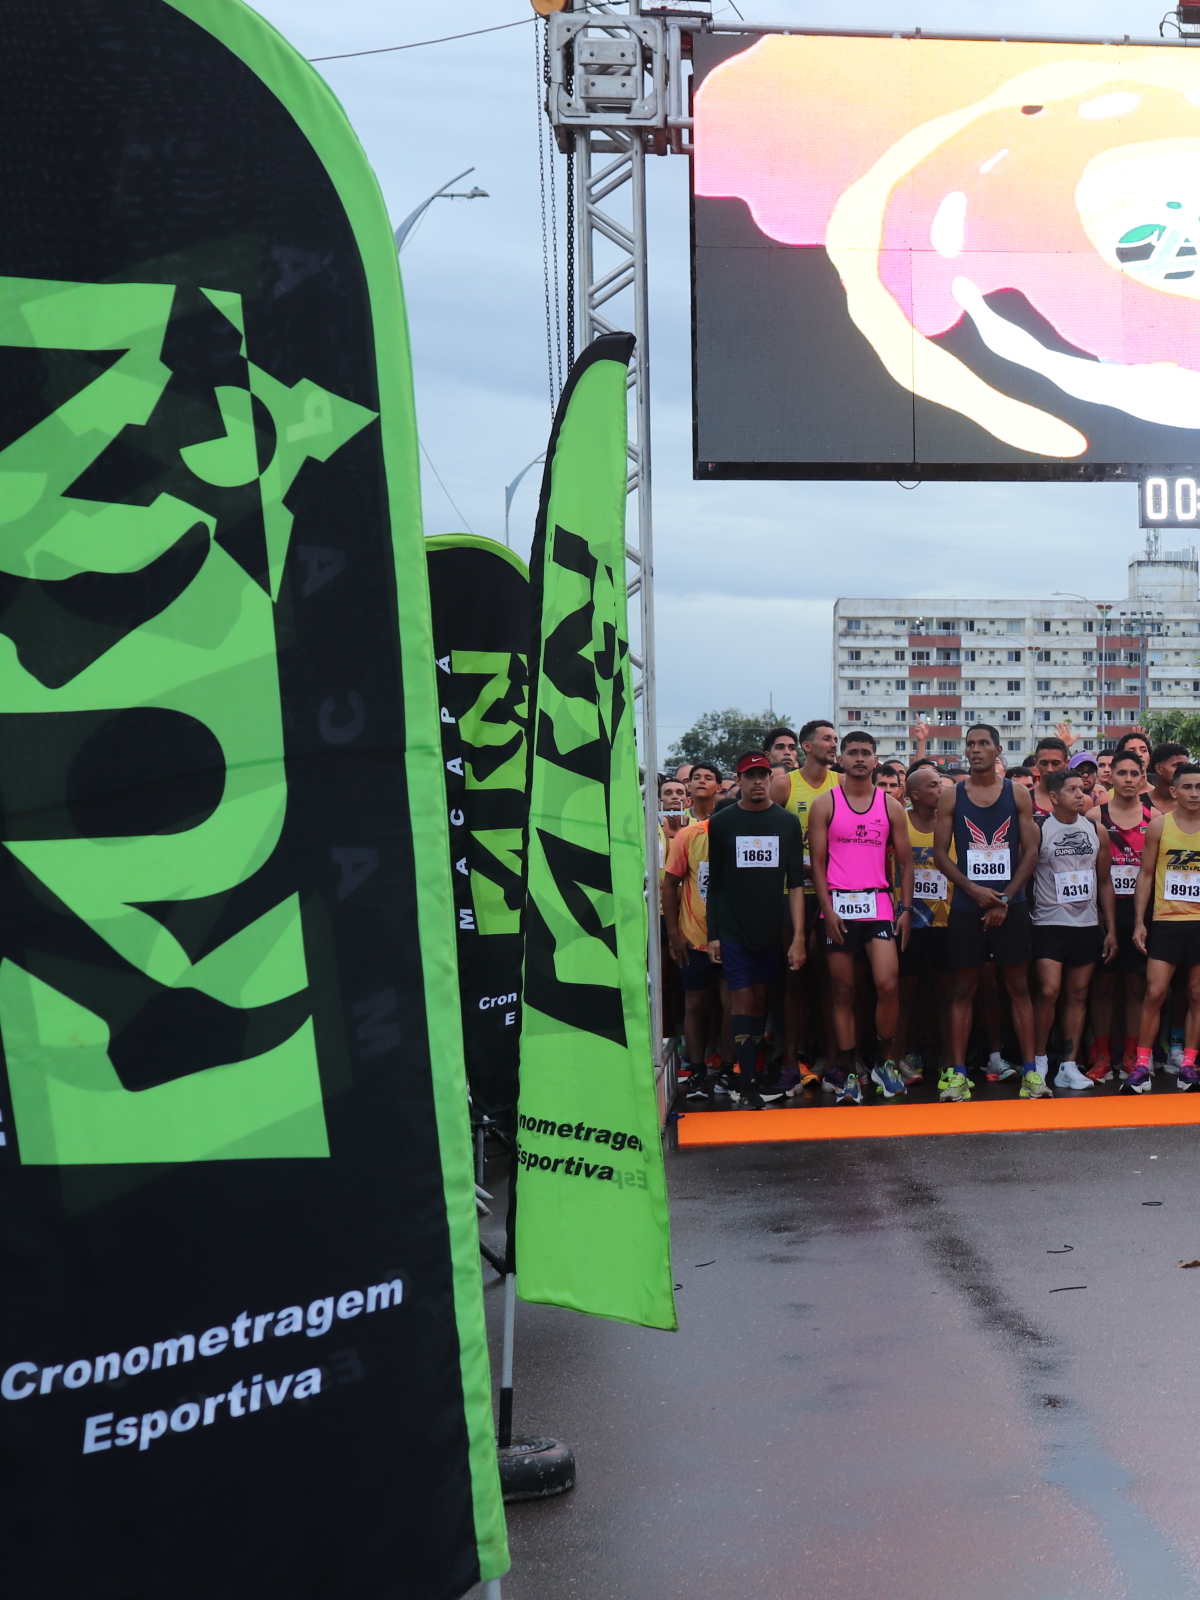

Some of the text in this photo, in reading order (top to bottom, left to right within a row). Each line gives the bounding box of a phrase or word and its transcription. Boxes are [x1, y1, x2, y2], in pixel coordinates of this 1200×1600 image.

[435, 655, 476, 930] MACAPÁ
[742, 850, 772, 861] 1863
[973, 863, 1006, 875] 6380
[914, 881, 938, 894] 963
[1114, 877, 1137, 889] 392
[1062, 883, 1089, 897] 4314
[1170, 884, 1200, 896] 8913
[838, 903, 871, 914] 4053
[518, 1113, 643, 1152] nometrage
[1, 1278, 404, 1402] Cronometragem
[82, 1366, 323, 1455] Esportiva
